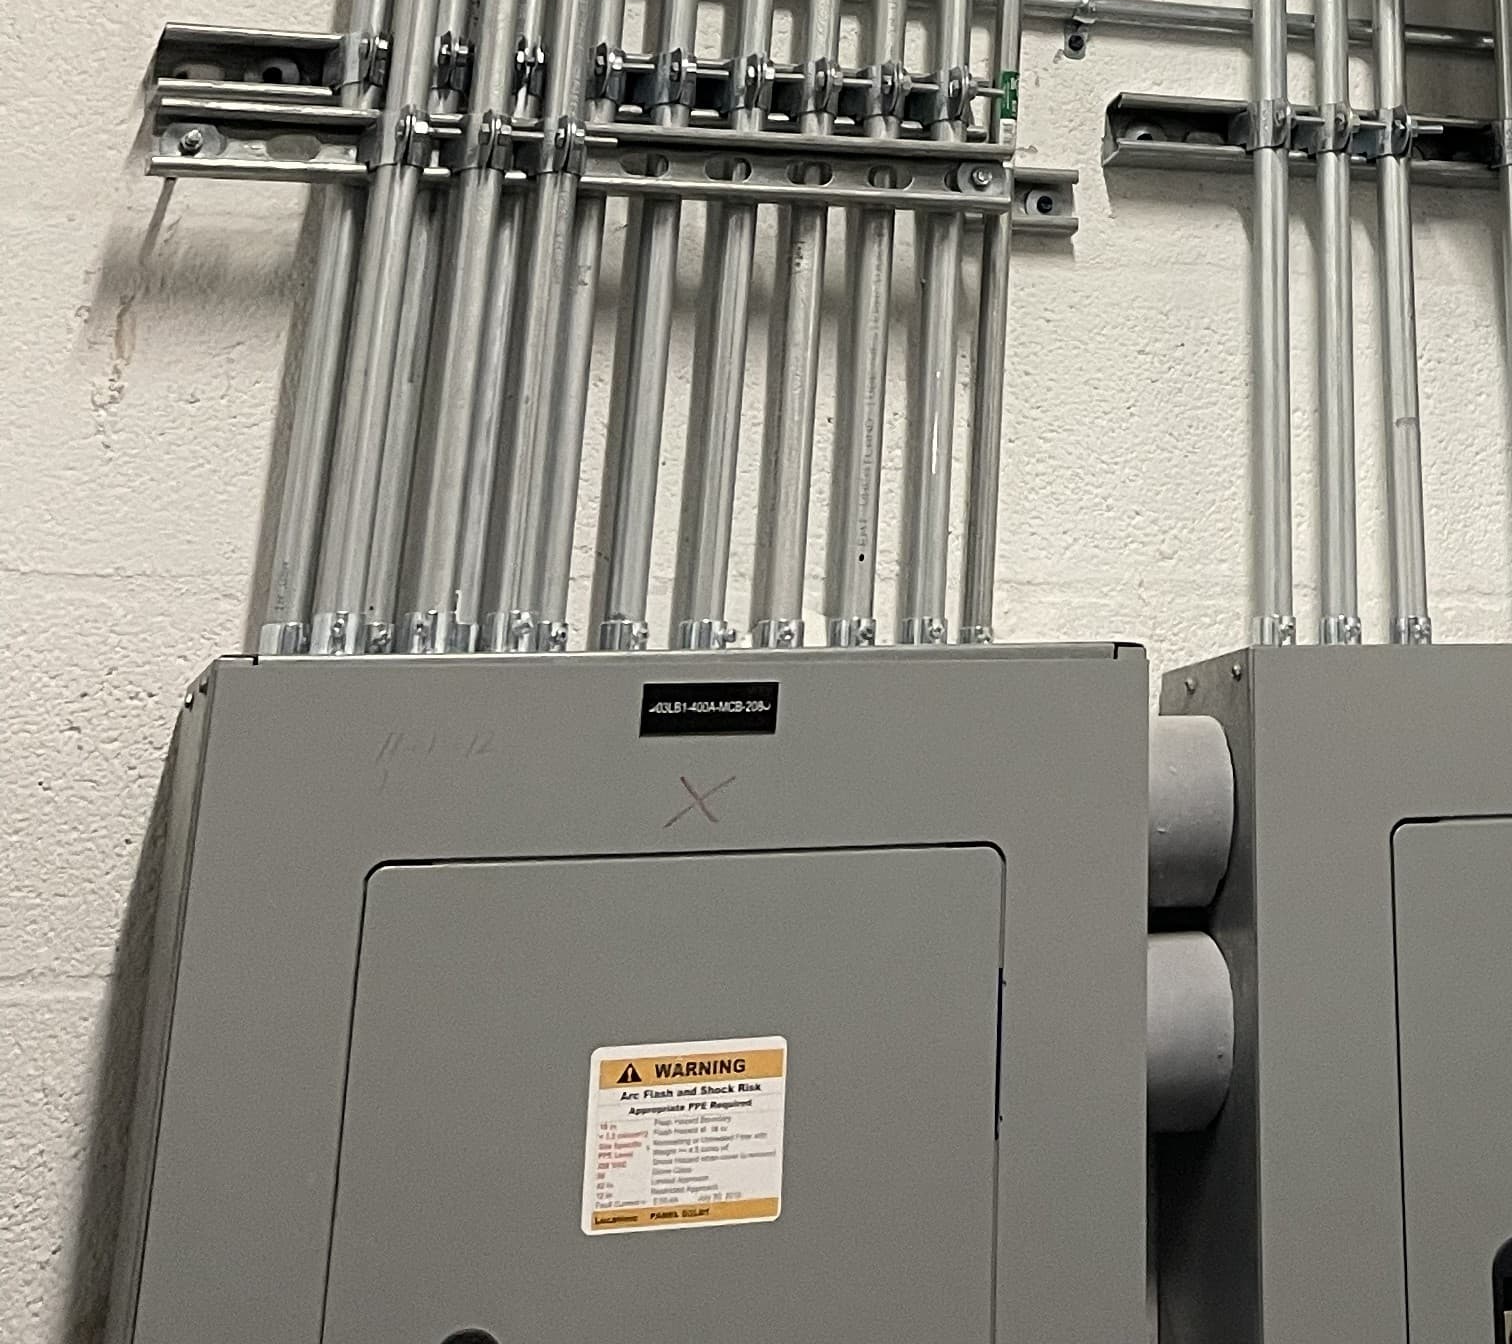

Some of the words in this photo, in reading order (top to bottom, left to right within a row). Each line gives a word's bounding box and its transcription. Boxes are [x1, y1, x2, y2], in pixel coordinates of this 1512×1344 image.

[654, 1059, 746, 1079] WARNING
[621, 1091, 640, 1101] Arc
[643, 1089, 673, 1100] Flash
[677, 1086, 697, 1097] and
[701, 1084, 734, 1096] Shock
[738, 1083, 762, 1093] Risk
[628, 1104, 685, 1116] Appropriate
[688, 1101, 706, 1111] PPE
[710, 1099, 753, 1111] Required
